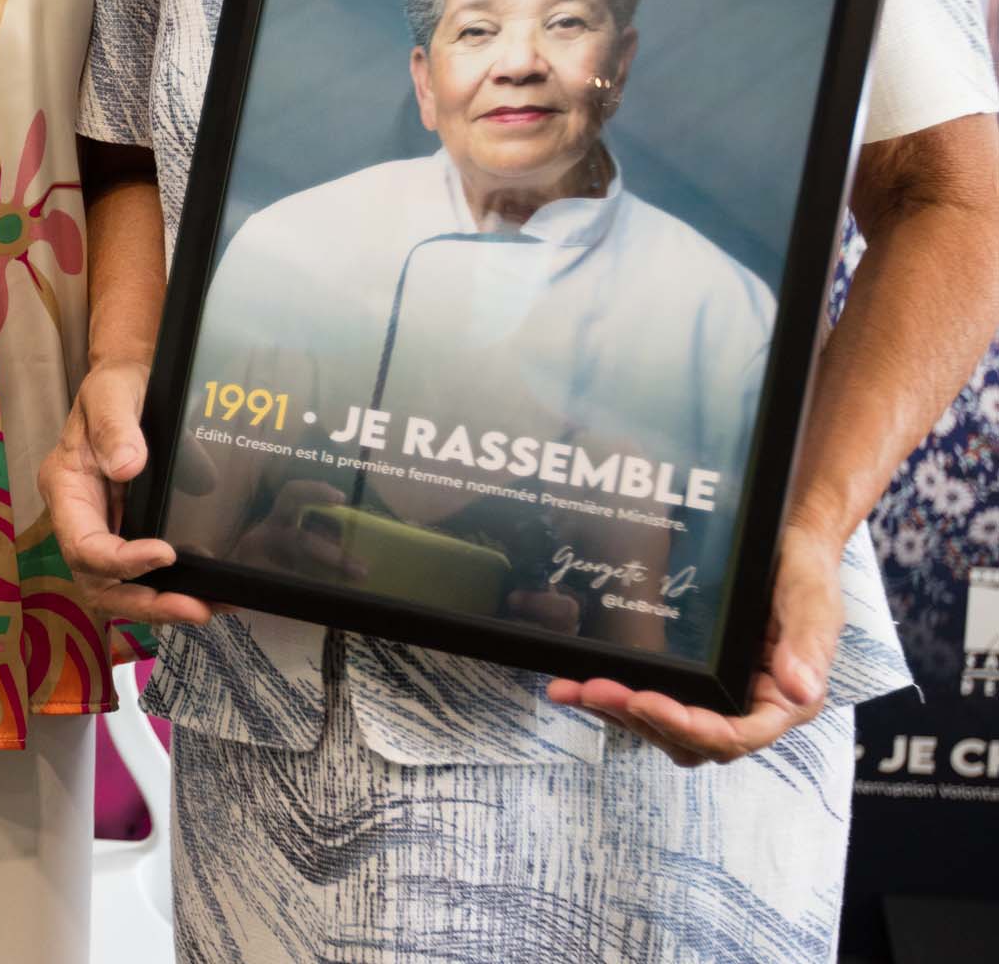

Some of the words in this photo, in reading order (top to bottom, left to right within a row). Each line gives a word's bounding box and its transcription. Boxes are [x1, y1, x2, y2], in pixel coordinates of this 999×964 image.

[195, 425, 232, 445] Édith
[235, 435, 292, 456] Cresson
[295, 447, 319, 461] est
[320, 450, 334, 464] la
[336, 456, 405, 478] première
[408, 467, 464, 490] femme
[466, 479, 537, 504] nommée
[540, 491, 613, 518] Première
[203, 380, 289, 432] 1991
[329, 405, 392, 451] JE
[402, 415, 720, 512] RASSEMBLE
[877, 734, 938, 775] JE
